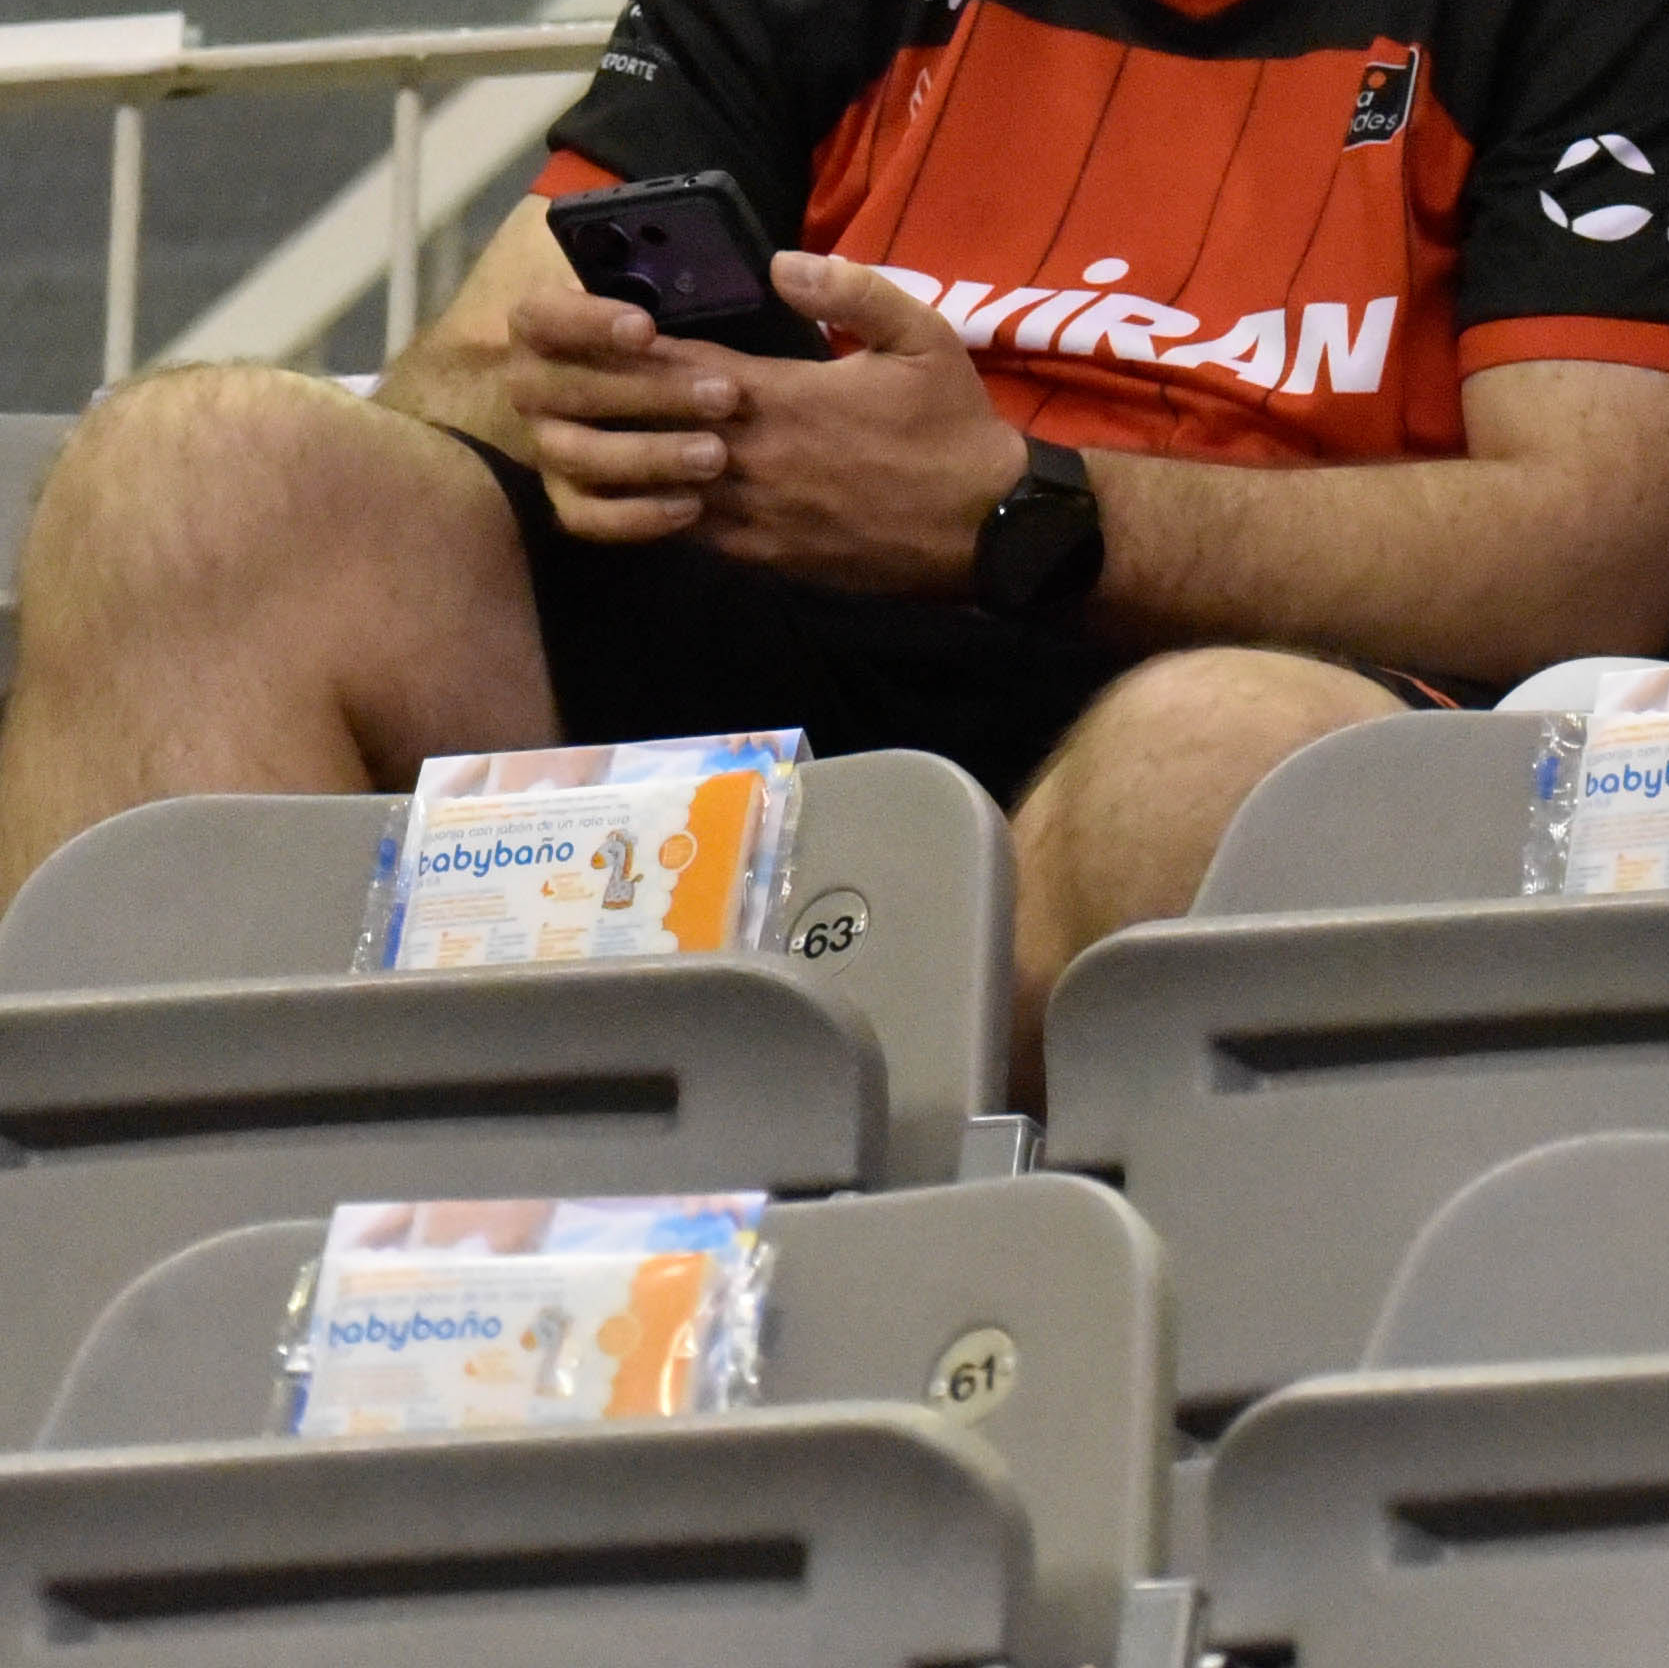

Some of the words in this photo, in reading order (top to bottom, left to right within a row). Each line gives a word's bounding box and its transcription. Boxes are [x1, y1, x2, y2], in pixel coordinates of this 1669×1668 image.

[418, 837, 575, 878] babybaño
[803, 915, 855, 960] 63
[949, 1353, 996, 1403] 61
